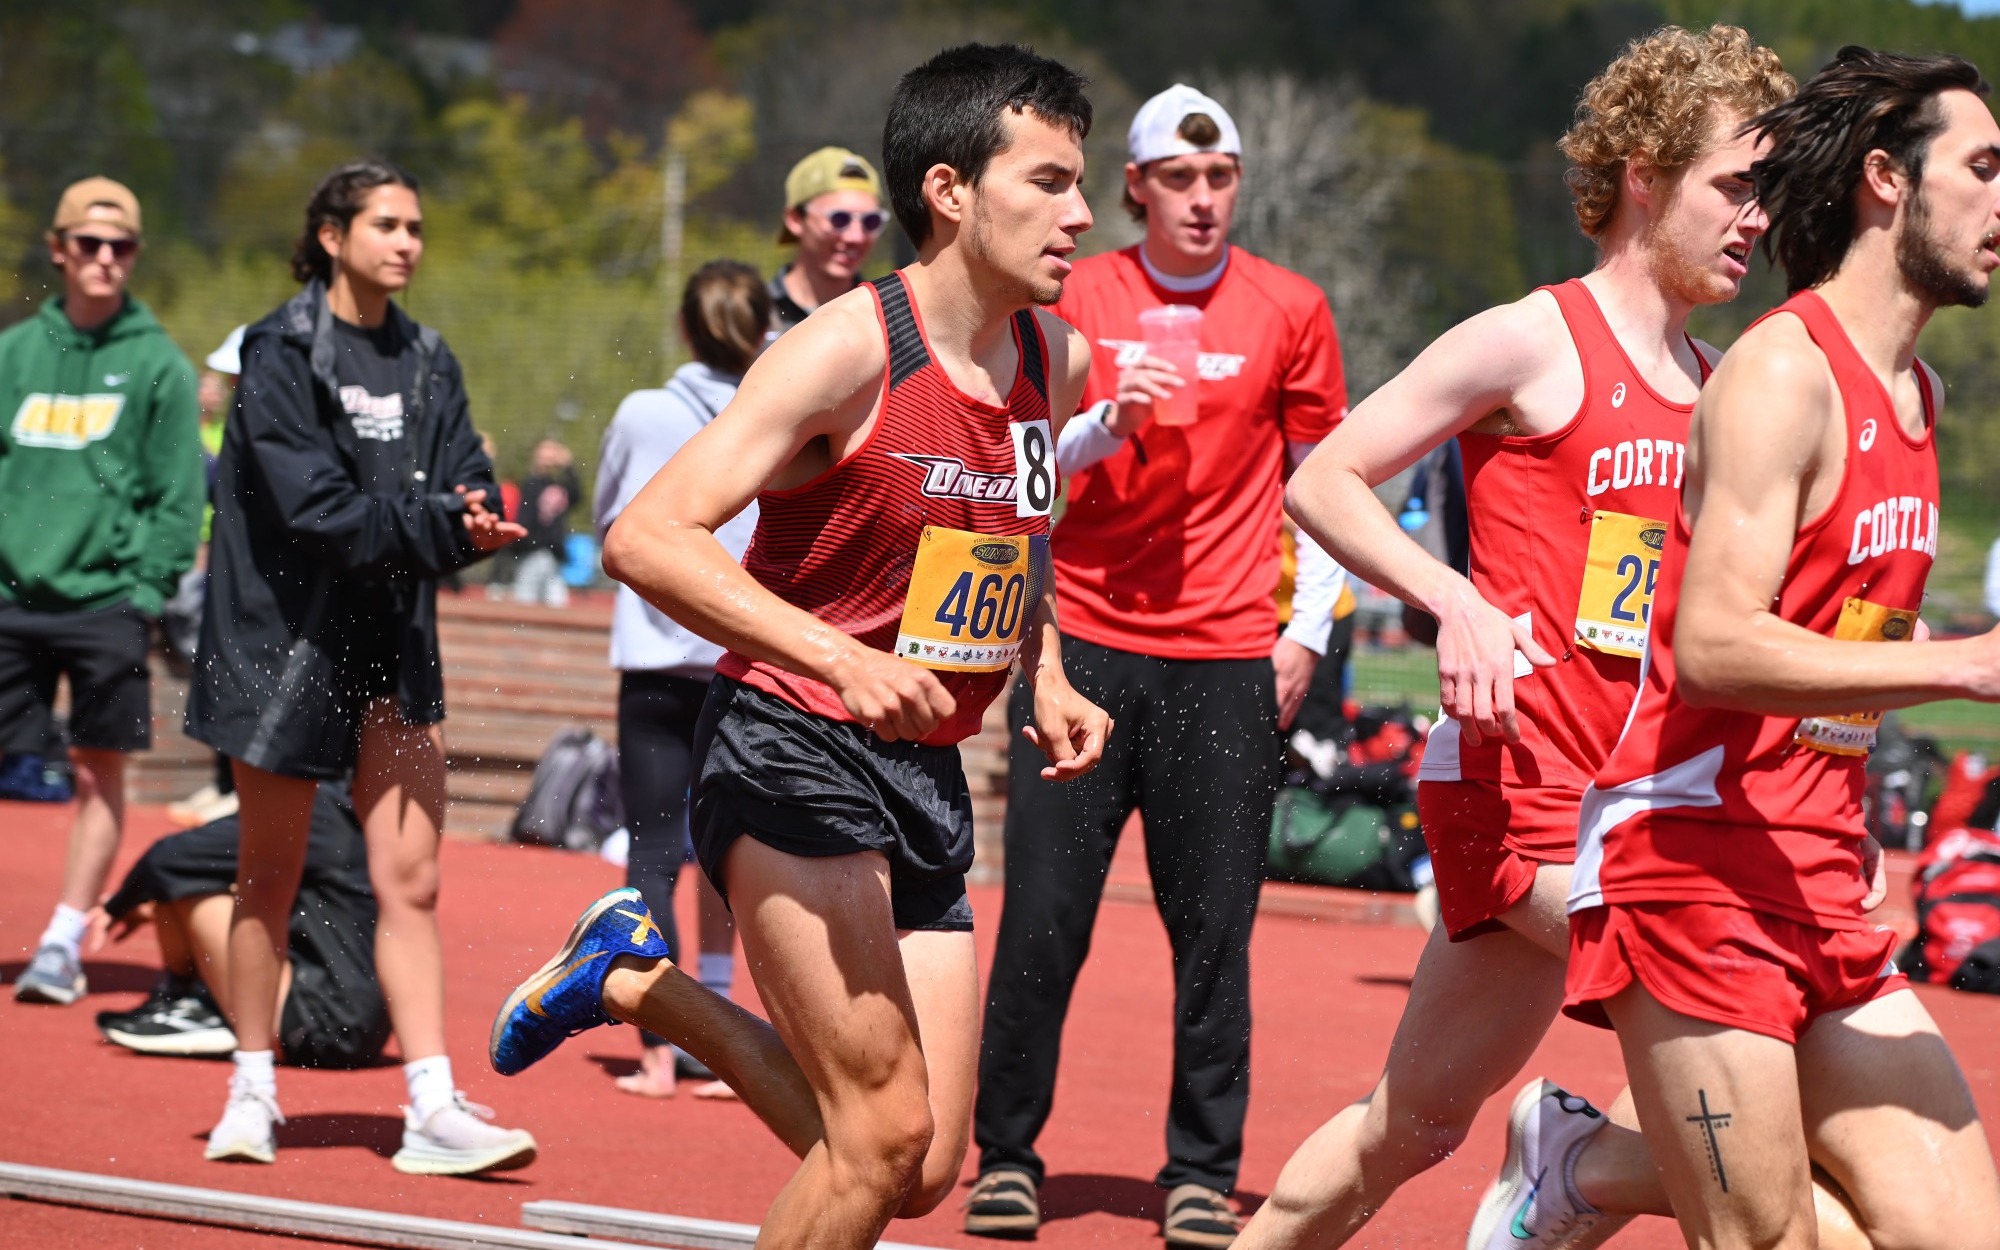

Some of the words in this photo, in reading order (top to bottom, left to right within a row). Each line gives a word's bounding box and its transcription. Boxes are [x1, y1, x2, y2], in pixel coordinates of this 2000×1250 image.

[921, 456, 1018, 501] ONEO
[1022, 425, 1051, 512] 8
[934, 571, 1025, 640] 460
